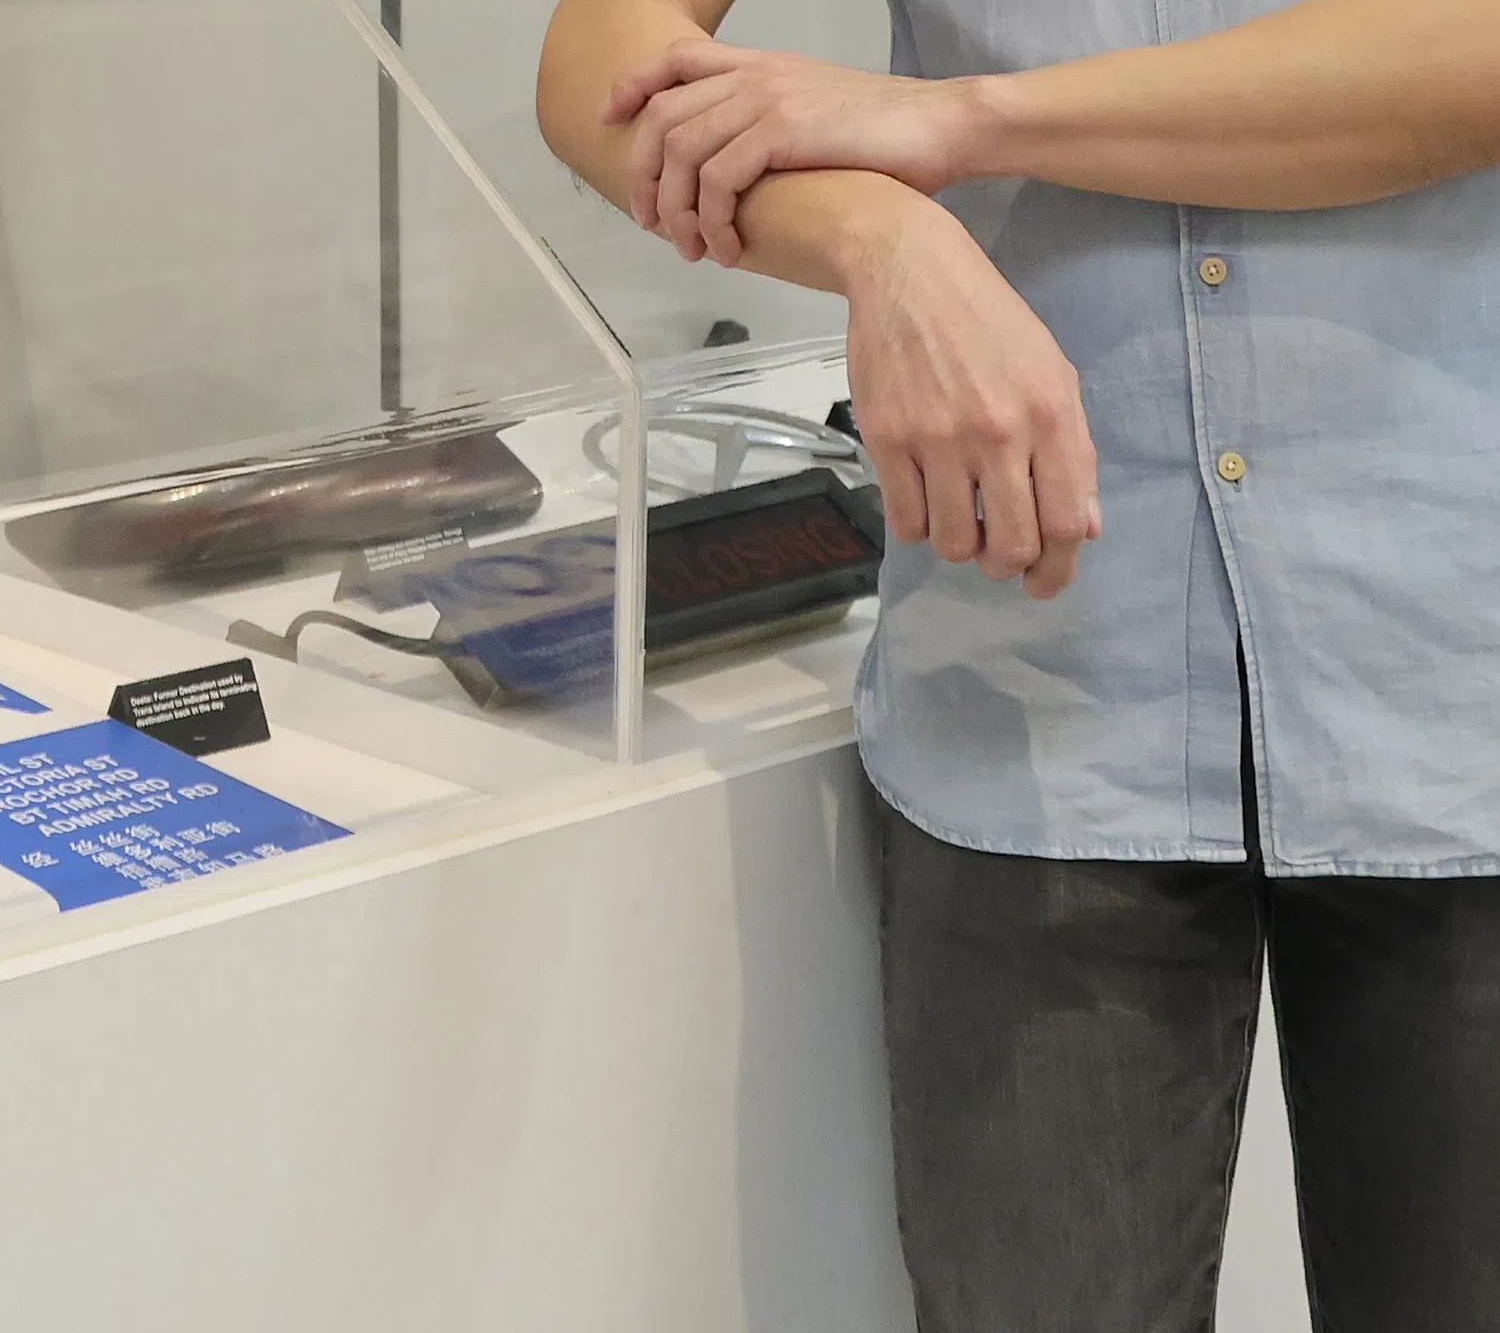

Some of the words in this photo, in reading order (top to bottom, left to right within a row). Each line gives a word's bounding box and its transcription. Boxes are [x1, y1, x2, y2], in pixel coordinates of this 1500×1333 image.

[20, 751, 57, 772] ST
[83, 753, 121, 775] ST
[97, 767, 141, 789] RD
[8, 804, 50, 827] BT
[45, 787, 132, 818] TIMAH
[130, 776, 173, 799] RD
[37, 793, 178, 839] ADMIRALTY
[176, 782, 220, 802] RD
